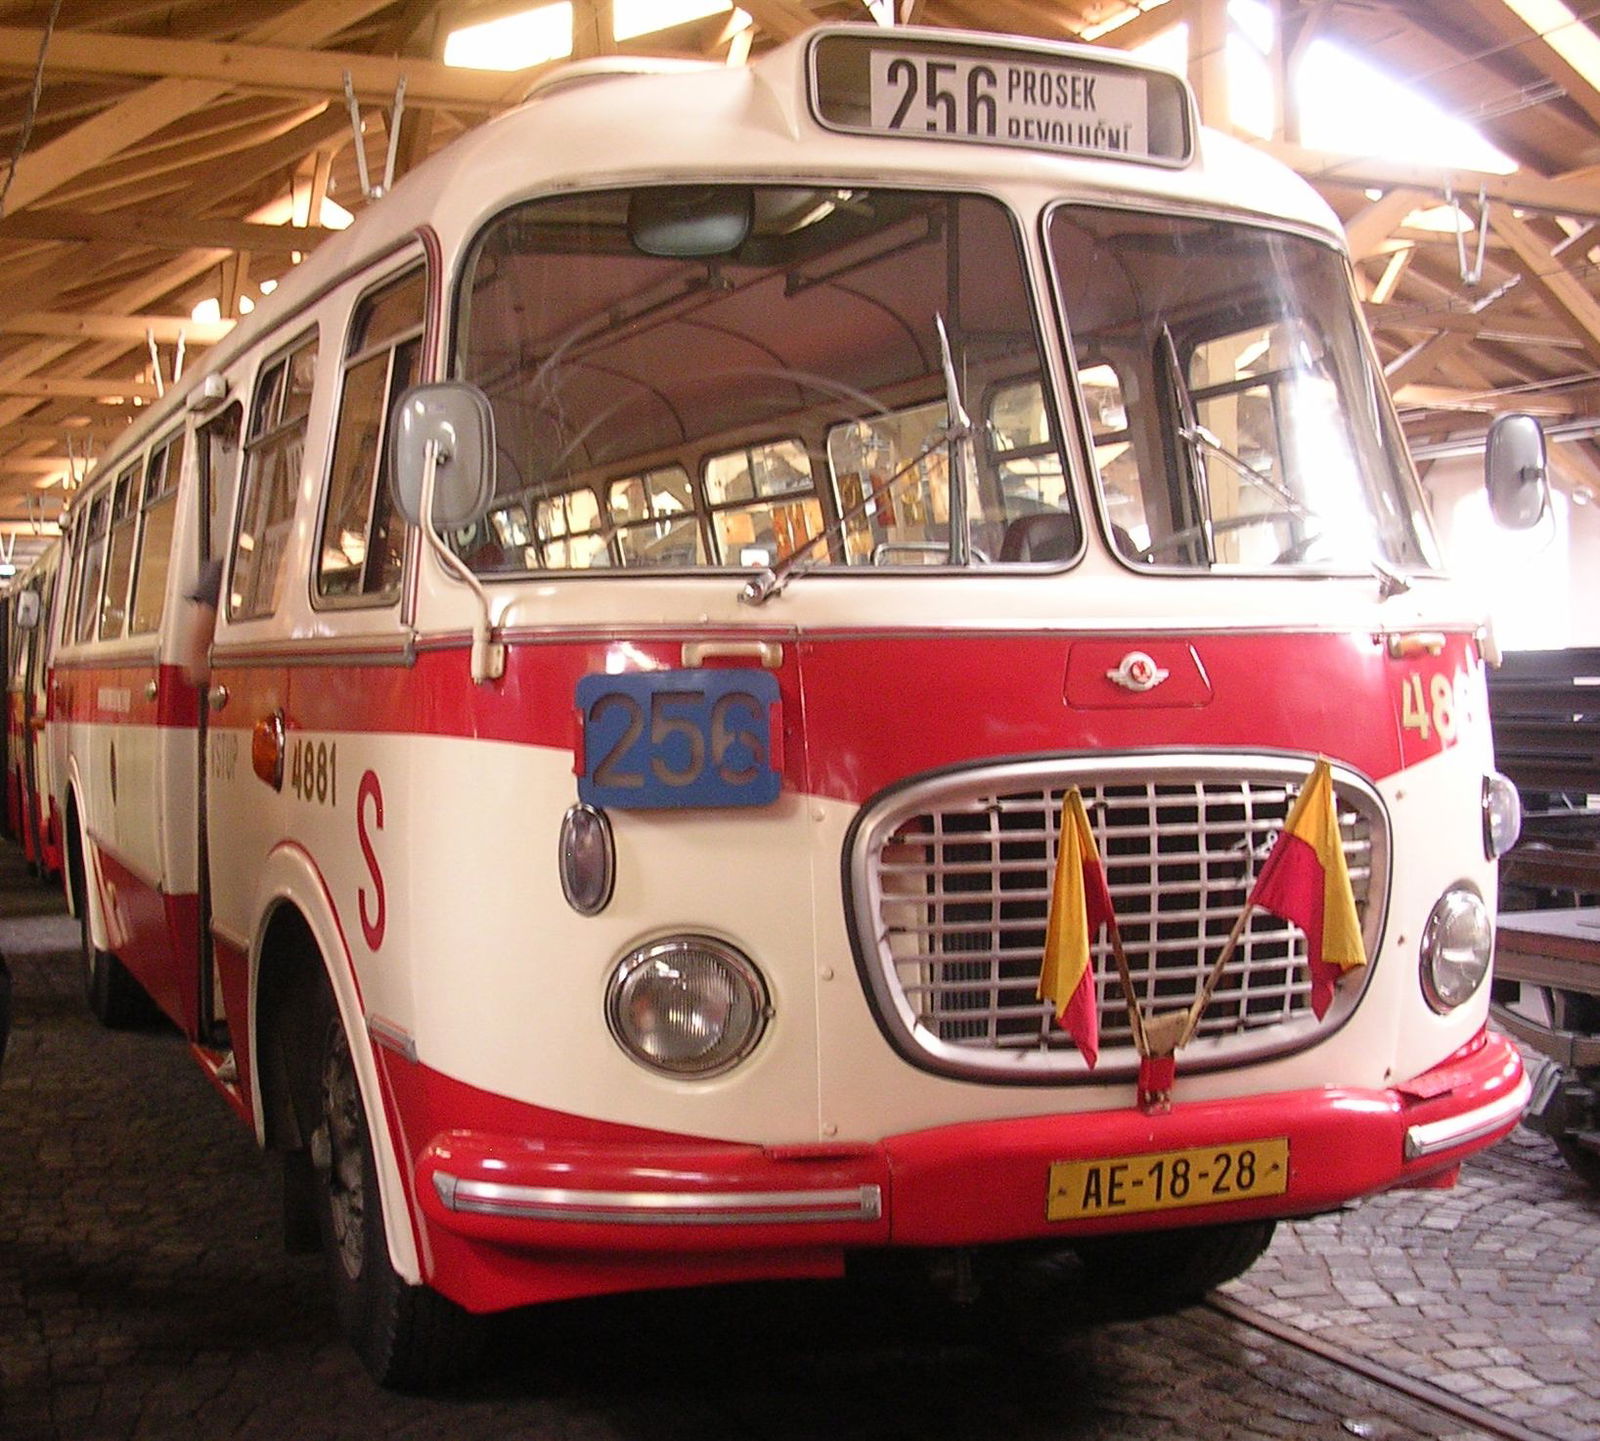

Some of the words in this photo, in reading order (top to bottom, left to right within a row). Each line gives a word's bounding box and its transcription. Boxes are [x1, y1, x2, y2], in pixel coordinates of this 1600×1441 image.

[887, 58, 997, 136] 256
[1007, 68, 1096, 112] PROSEK
[292, 738, 336, 807] 4881
[589, 691, 766, 787] 256
[356, 769, 386, 952] S
[1082, 1150, 1256, 1210] AE-18-28
